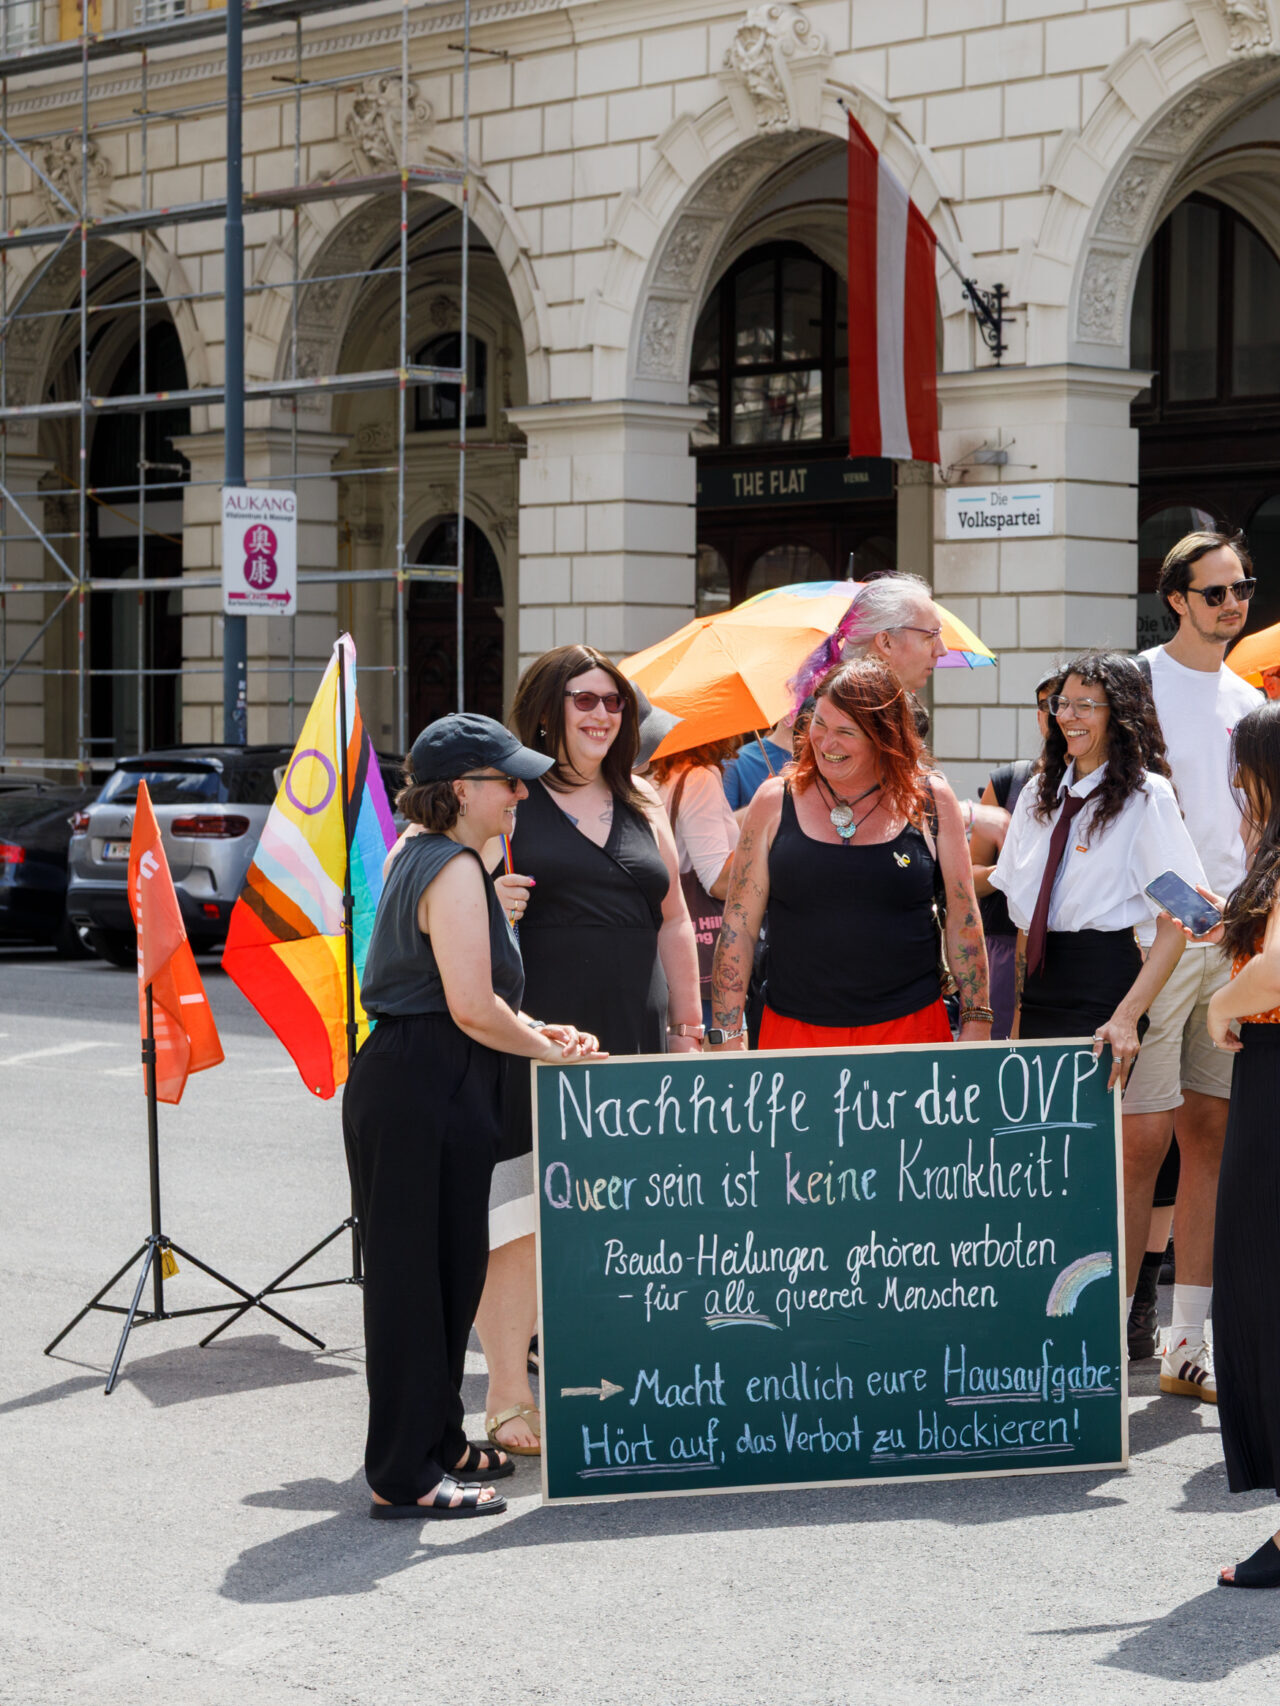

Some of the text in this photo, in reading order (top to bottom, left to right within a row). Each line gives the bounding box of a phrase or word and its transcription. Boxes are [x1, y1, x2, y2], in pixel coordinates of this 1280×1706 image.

[225, 495, 294, 512] AUKANG
[732, 471, 764, 497] THE
[770, 468, 807, 495] FLAT
[843, 472, 870, 484] VIENNA
[990, 491, 1008, 506] Die
[958, 507, 1041, 531] Volkspartei
[559, 1047, 1099, 1148] Nachhilfe für die ÖVP
[544, 1134, 1071, 1211] Queer sein ist keine Krankheit!
[604, 1222, 1056, 1286] Pseudo-Heilungen gehören verboten
[643, 1281, 689, 1323] für
[704, 1278, 760, 1315] alle
[776, 1287, 868, 1328] queeren
[877, 1276, 999, 1312] Menschen
[629, 1338, 1121, 1407] Macht endlich eure Hausaufgabe:
[581, 1407, 1081, 1466] Hört auf, das Verbot zu blockieren!
